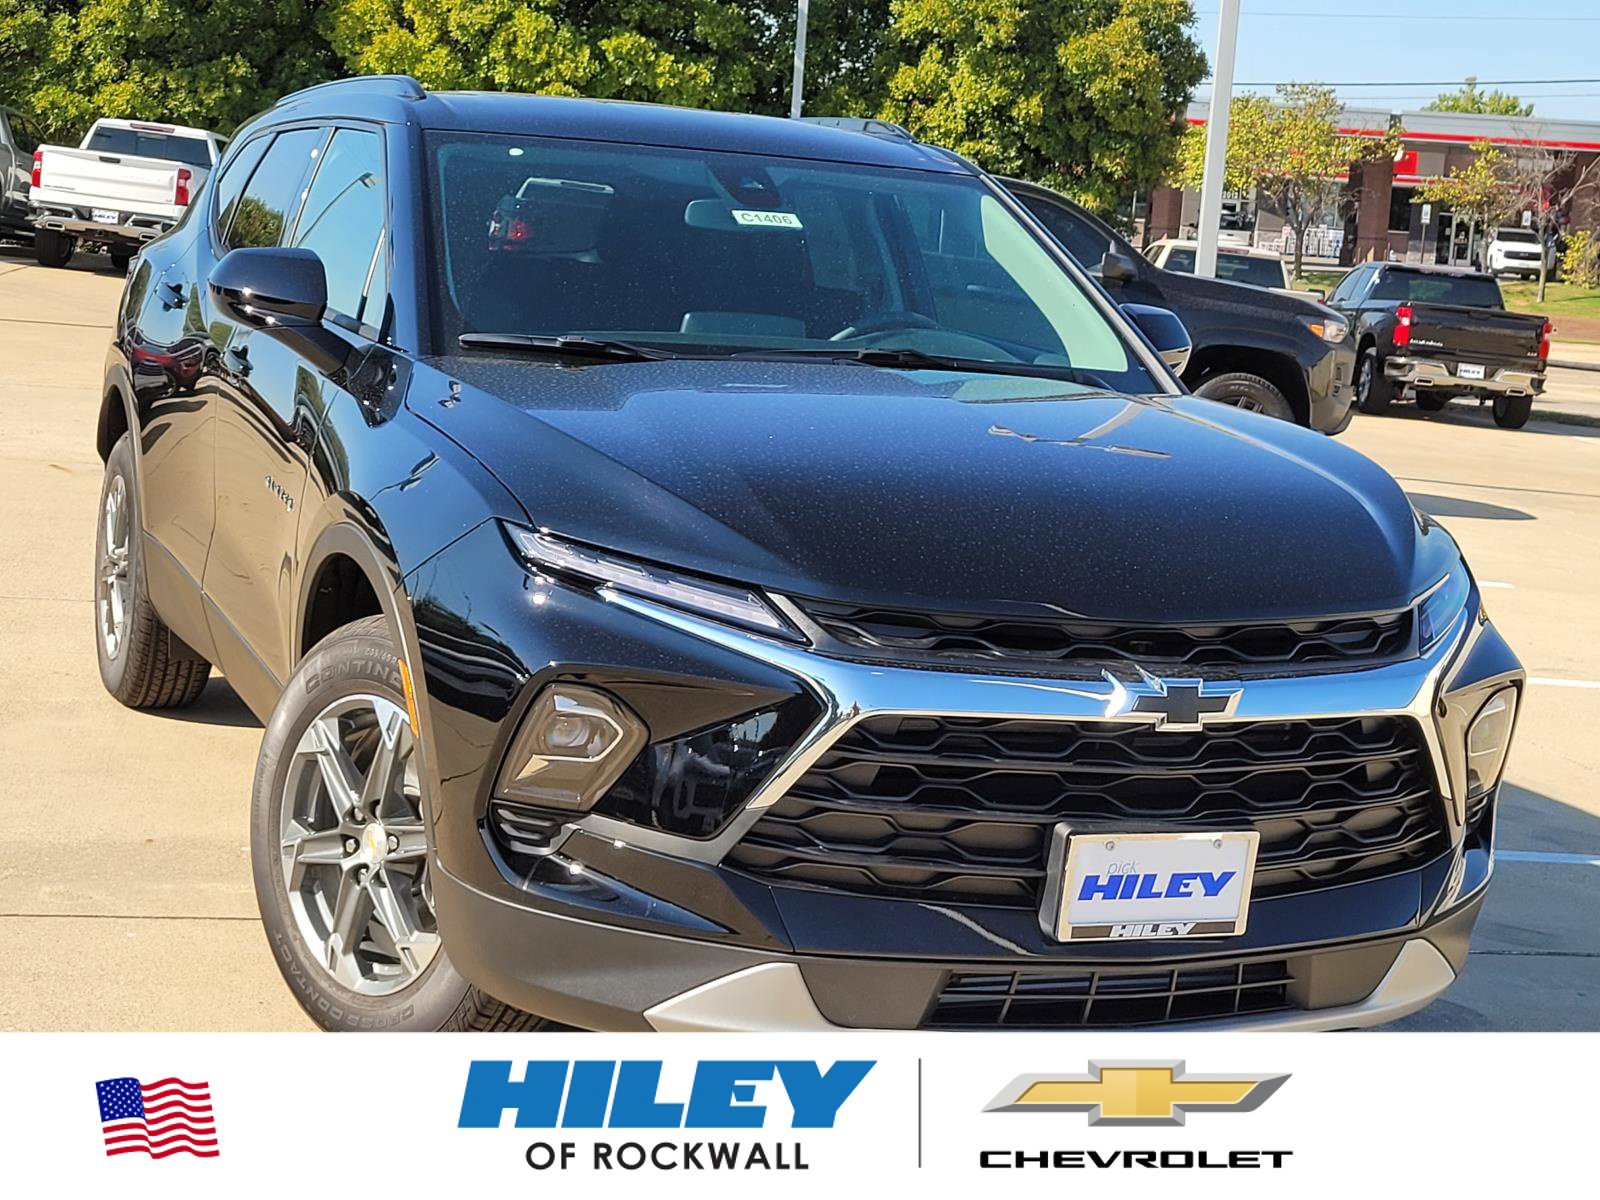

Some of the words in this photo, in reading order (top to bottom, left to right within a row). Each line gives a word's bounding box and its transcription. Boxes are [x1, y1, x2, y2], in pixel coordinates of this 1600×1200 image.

[1107, 860, 1139, 876] pick
[1077, 870, 1237, 901] HILEY
[1110, 923, 1196, 938] HILEY
